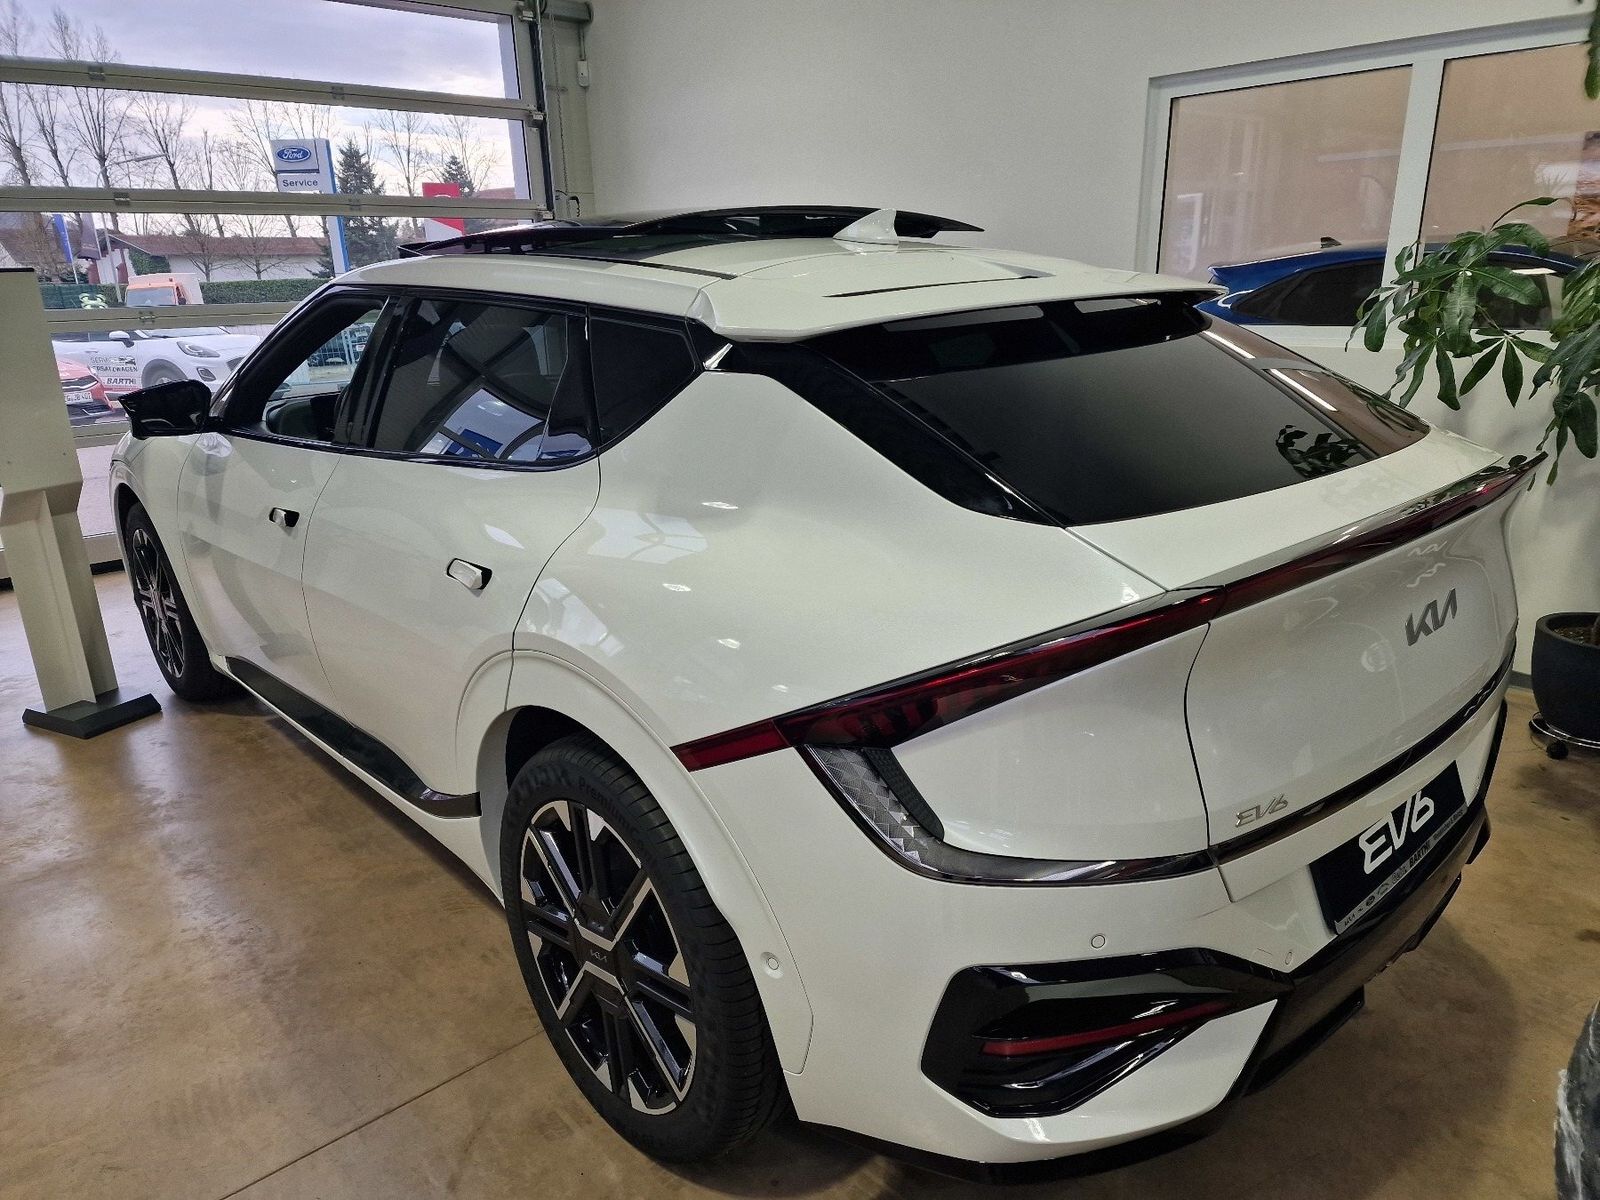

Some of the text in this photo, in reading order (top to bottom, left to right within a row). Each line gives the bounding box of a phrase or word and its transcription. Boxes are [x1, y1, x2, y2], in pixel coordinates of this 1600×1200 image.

[282, 147, 303, 158] Ford
[282, 179, 318, 187] Service
[1405, 588, 1457, 646] KIA
[1235, 794, 1288, 828] EV6
[1359, 790, 1434, 875] EV6
